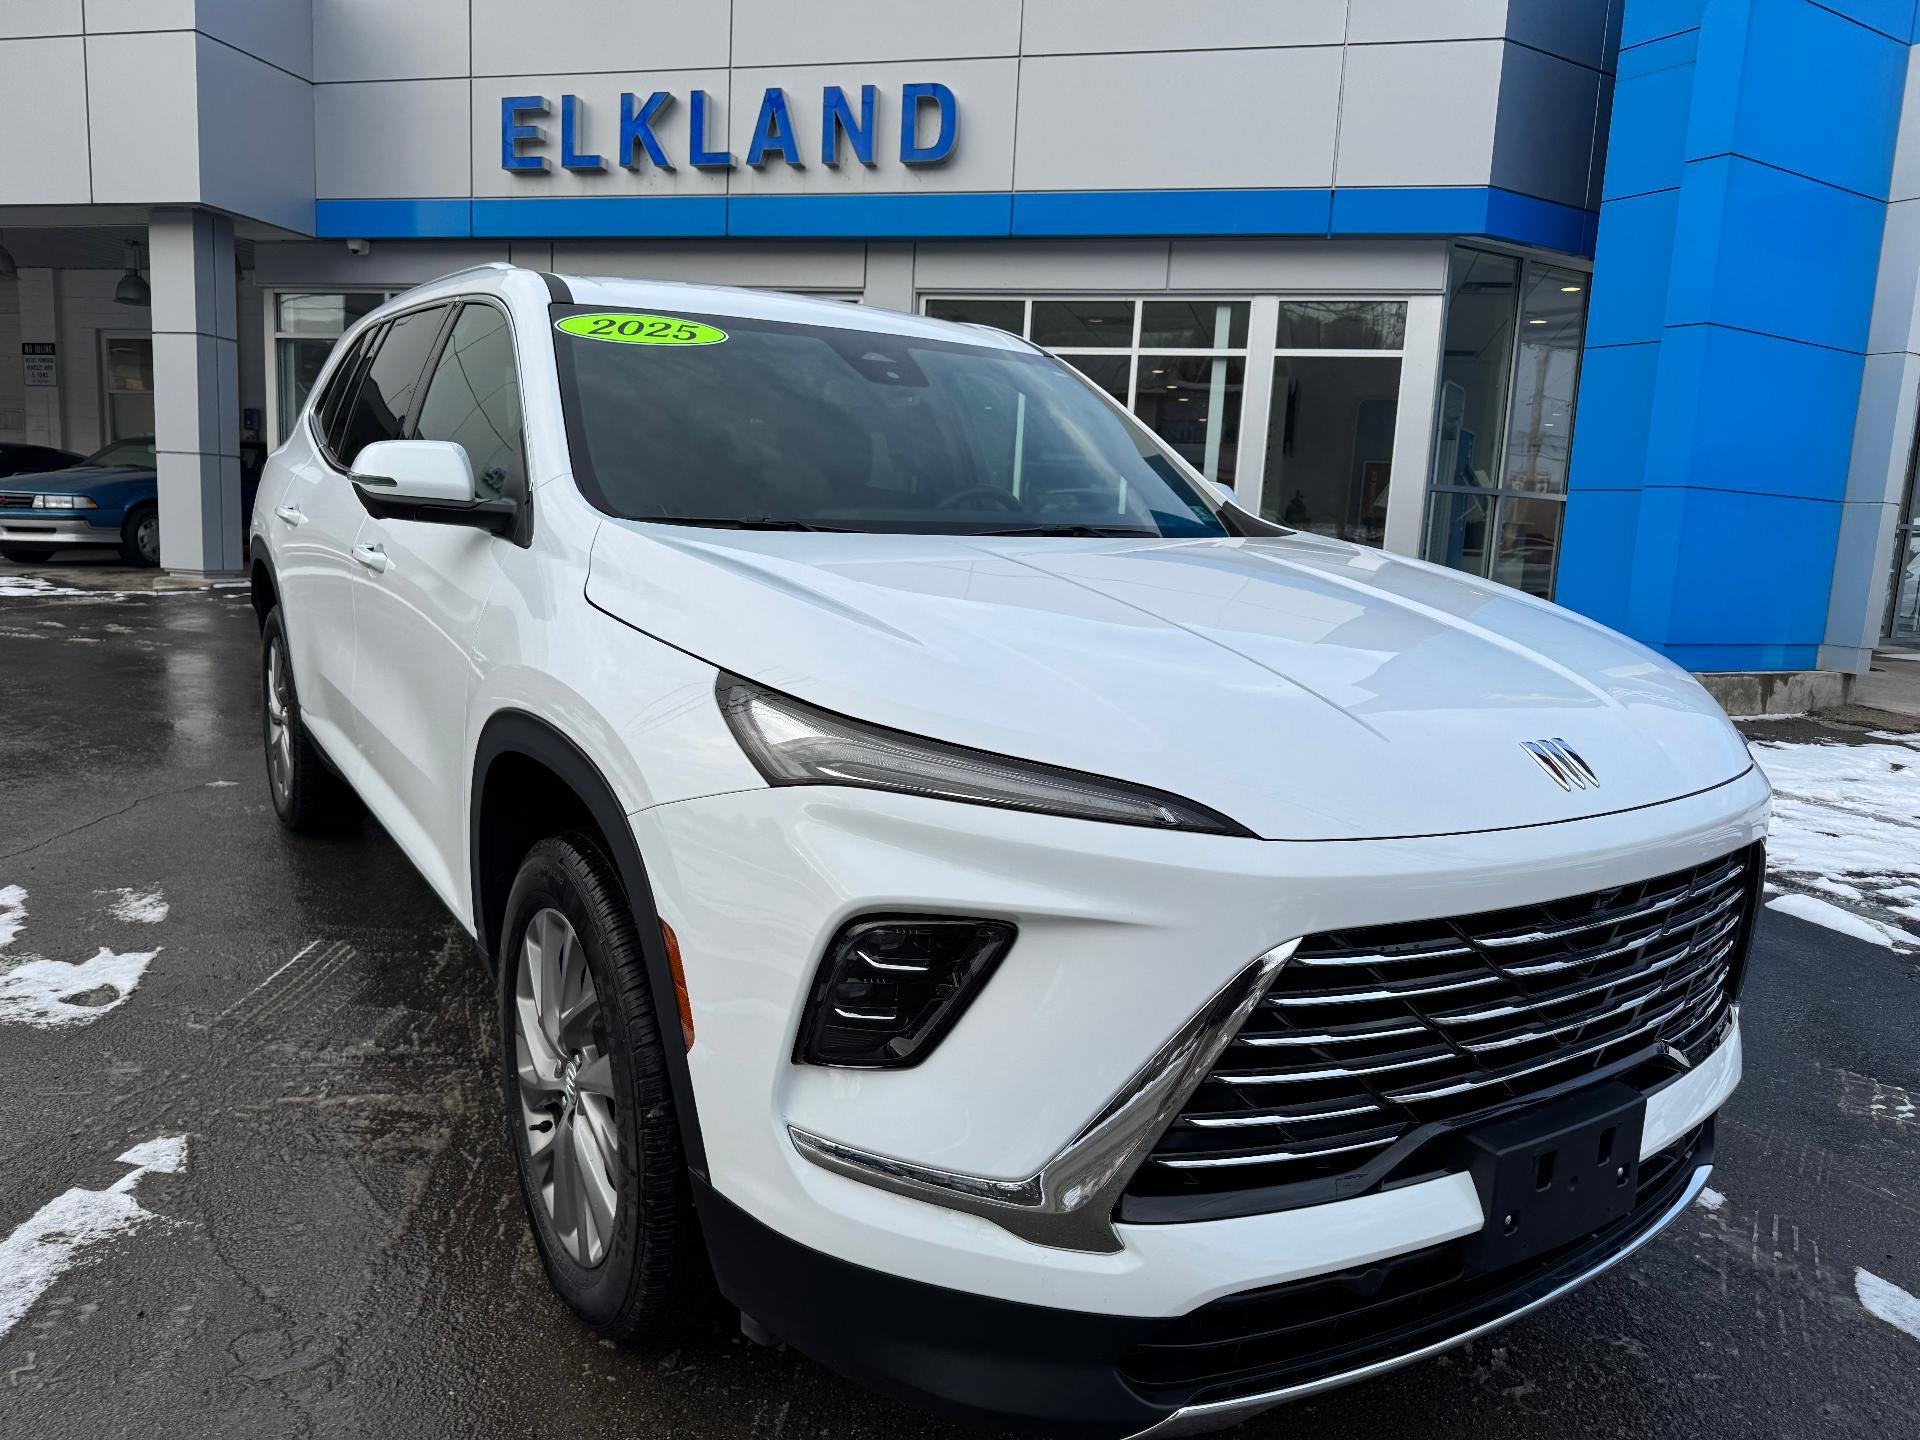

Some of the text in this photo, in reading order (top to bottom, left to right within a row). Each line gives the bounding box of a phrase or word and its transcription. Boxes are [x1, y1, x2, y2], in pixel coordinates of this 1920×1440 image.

[501, 82, 960, 172] ELKLAND
[586, 318, 700, 341] 2025
[24, 344, 33, 354] NO
